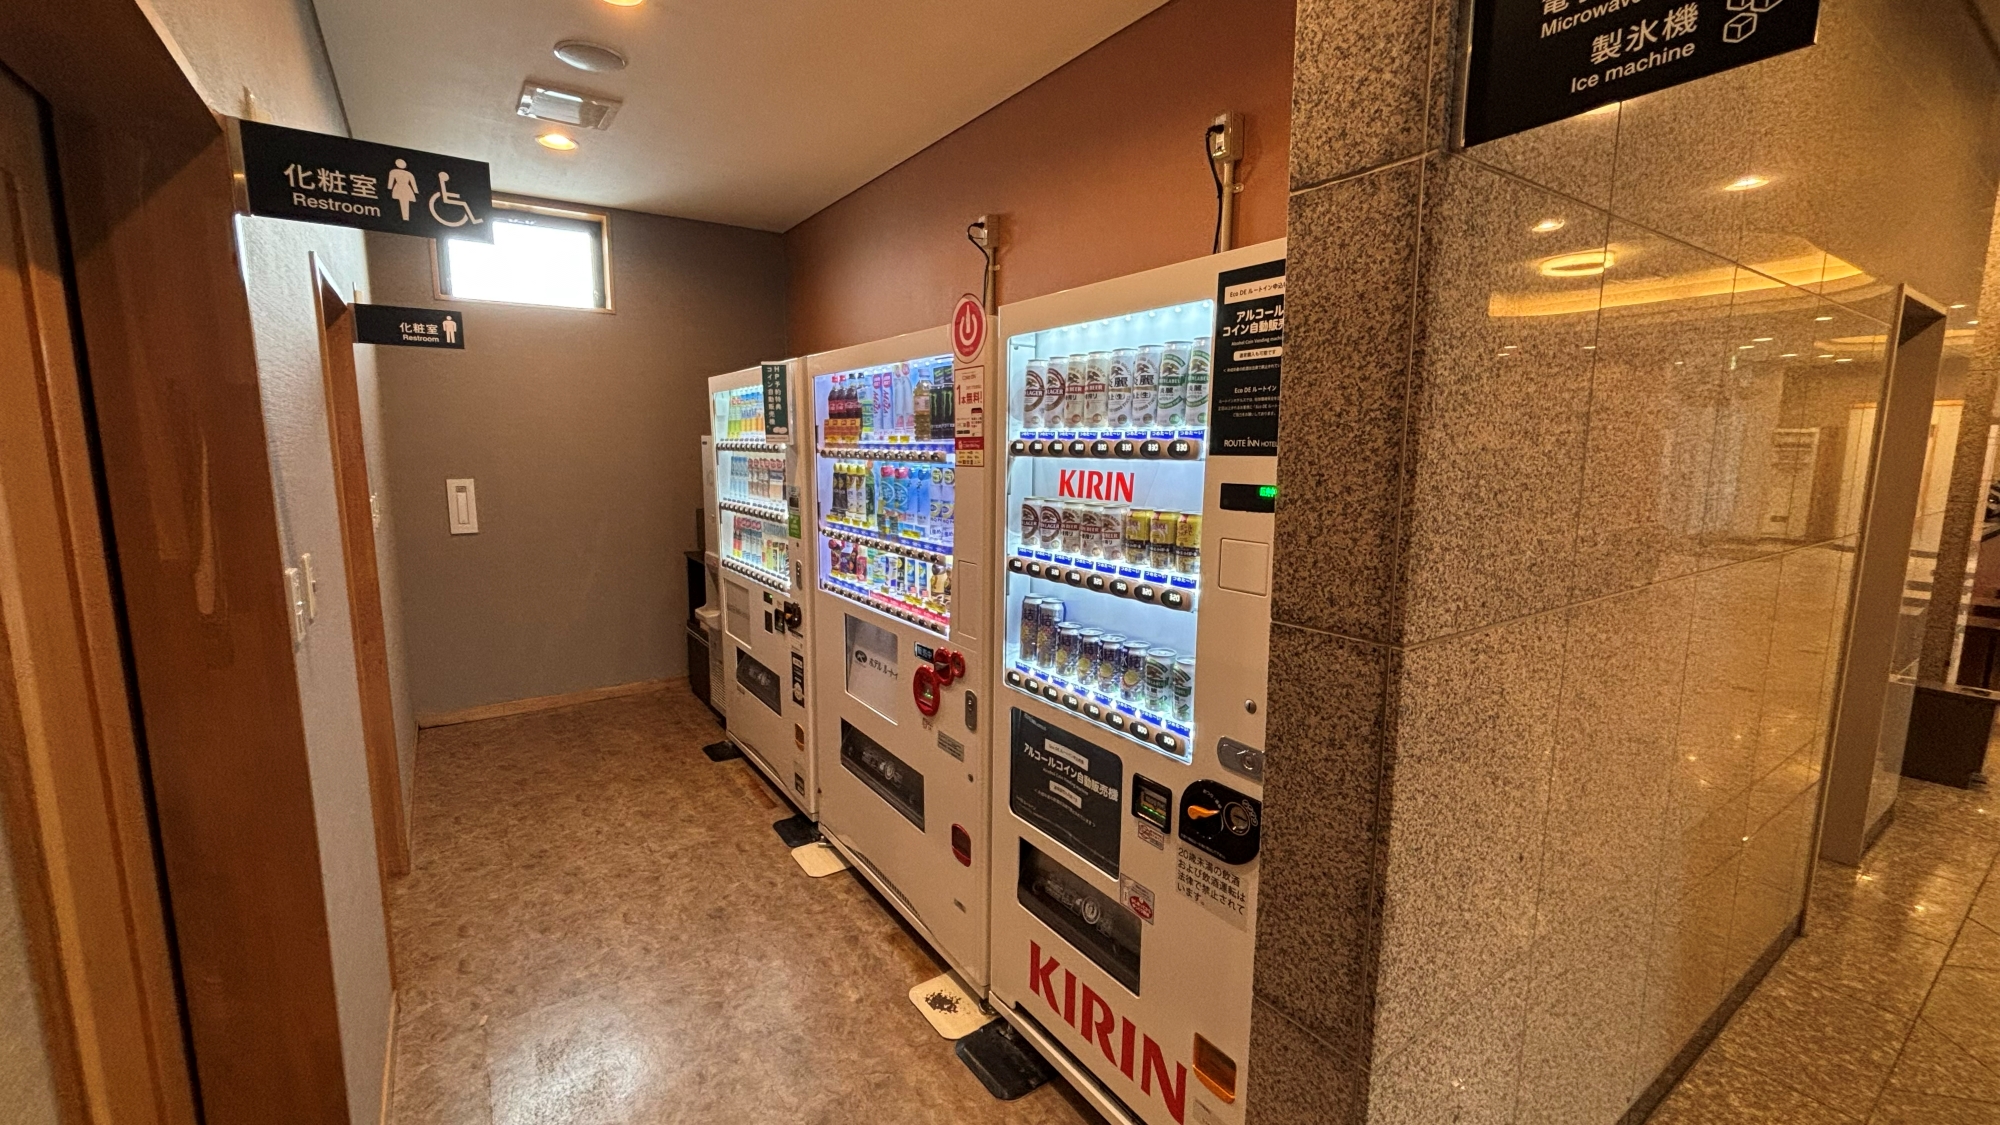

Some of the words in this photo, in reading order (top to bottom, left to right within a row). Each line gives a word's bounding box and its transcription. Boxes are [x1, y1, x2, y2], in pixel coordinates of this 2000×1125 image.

[1590, 2, 1699, 65] 製氷機
[1570, 74, 1600, 93] Ice
[1605, 43, 1696, 83] machine
[283, 164, 378, 199] 化粧室
[292, 192, 381, 217] Restroom
[399, 322, 438, 335] 化粧室
[1222, 318, 1284, 336] コイン自動販売
[1236, 304, 1284, 322] アルコール
[402, 334, 440, 342] Restroom
[1059, 469, 1134, 502] KIRIN
[883, 663, 898, 680] ルートイ
[1024, 742, 1118, 802] アルコールコイン自動販売機
[1178, 848, 1240, 887] 20歳未満の飲酒
[1178, 860, 1245, 902] および飲酒運転は
[1178, 870, 1245, 915] 法律で禁止されて
[1178, 883, 1204, 906] います。
[1029, 939, 1187, 1125] KIRIN
